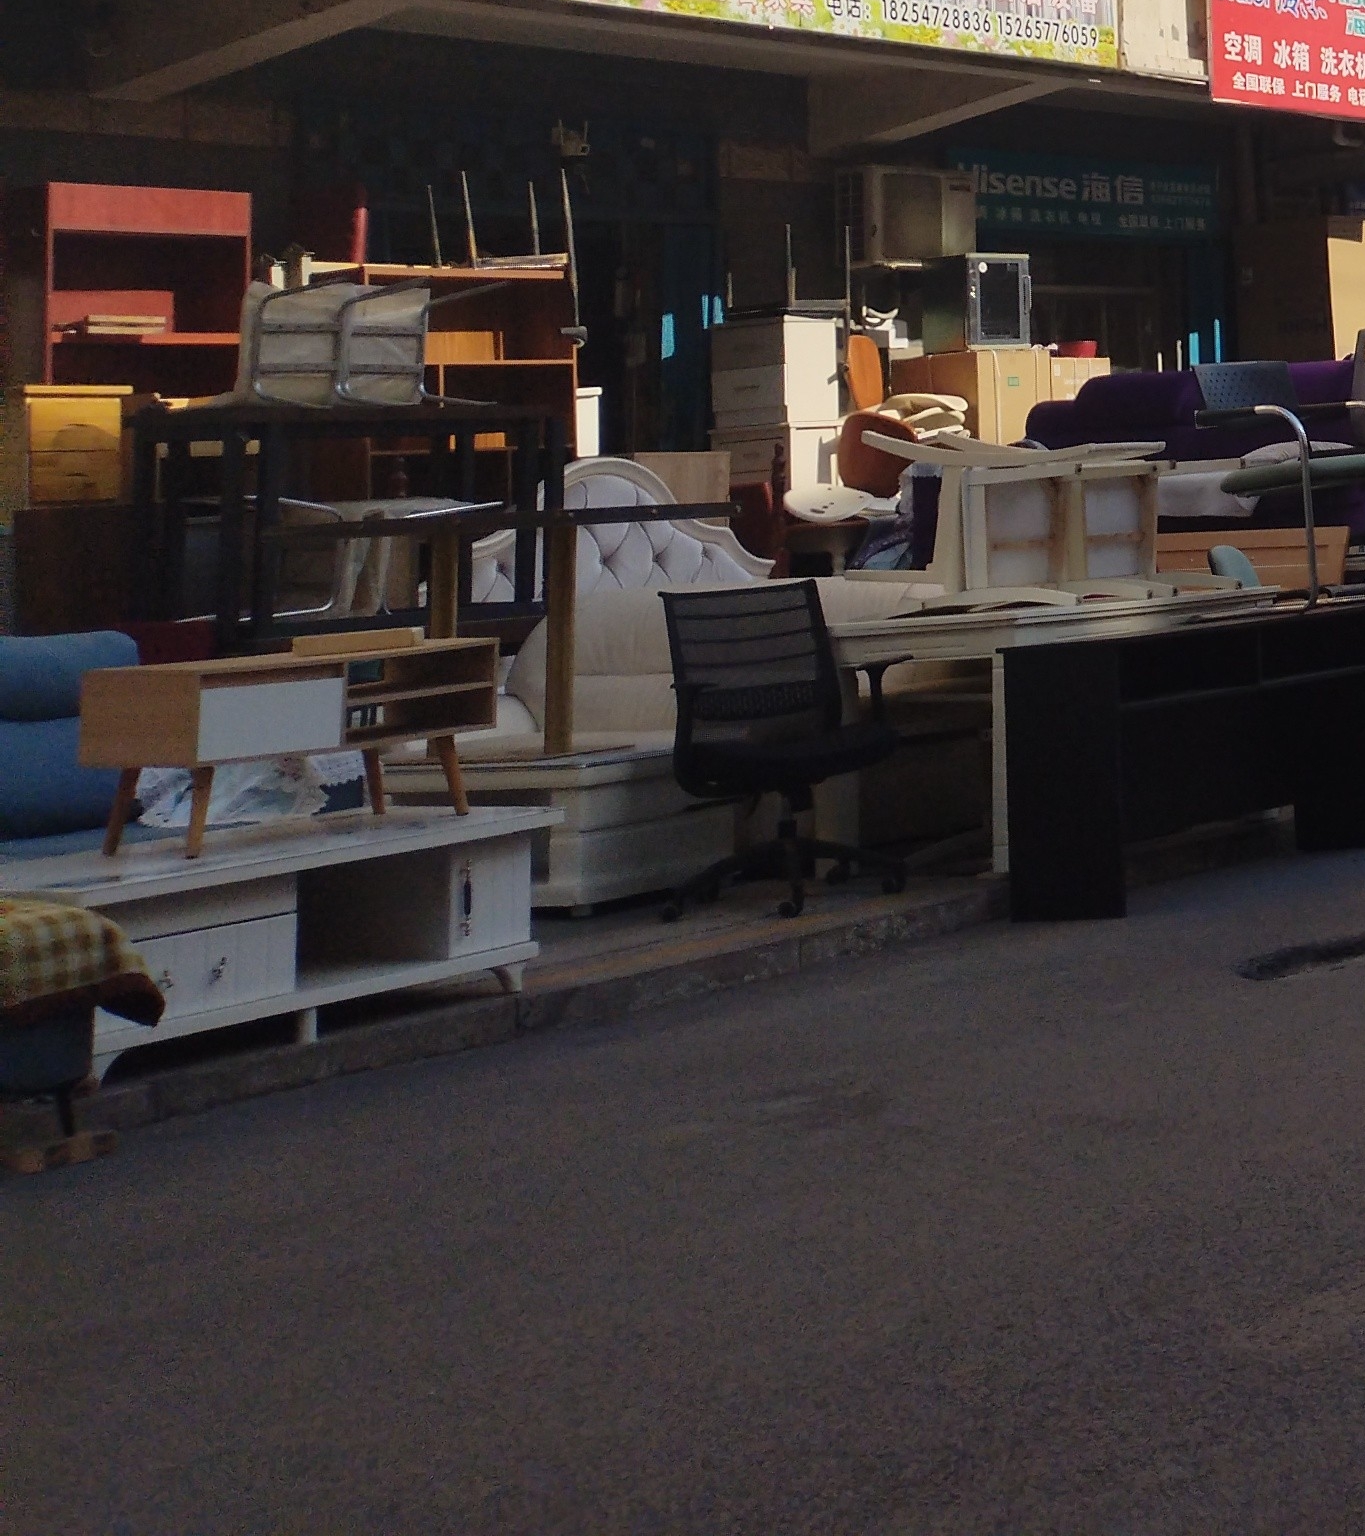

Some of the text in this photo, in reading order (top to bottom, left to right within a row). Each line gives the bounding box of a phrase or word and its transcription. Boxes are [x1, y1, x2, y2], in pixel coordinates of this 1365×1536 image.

[997, 15, 1098, 47] 15265776059
[1224, 31, 1262, 65] 空调
[1273, 39, 1310, 72] 冰箱
[1232, 72, 1285, 95] 全国联保
[1292, 81, 1341, 104] 上门服务
[1081, 171, 1144, 206] 海信
